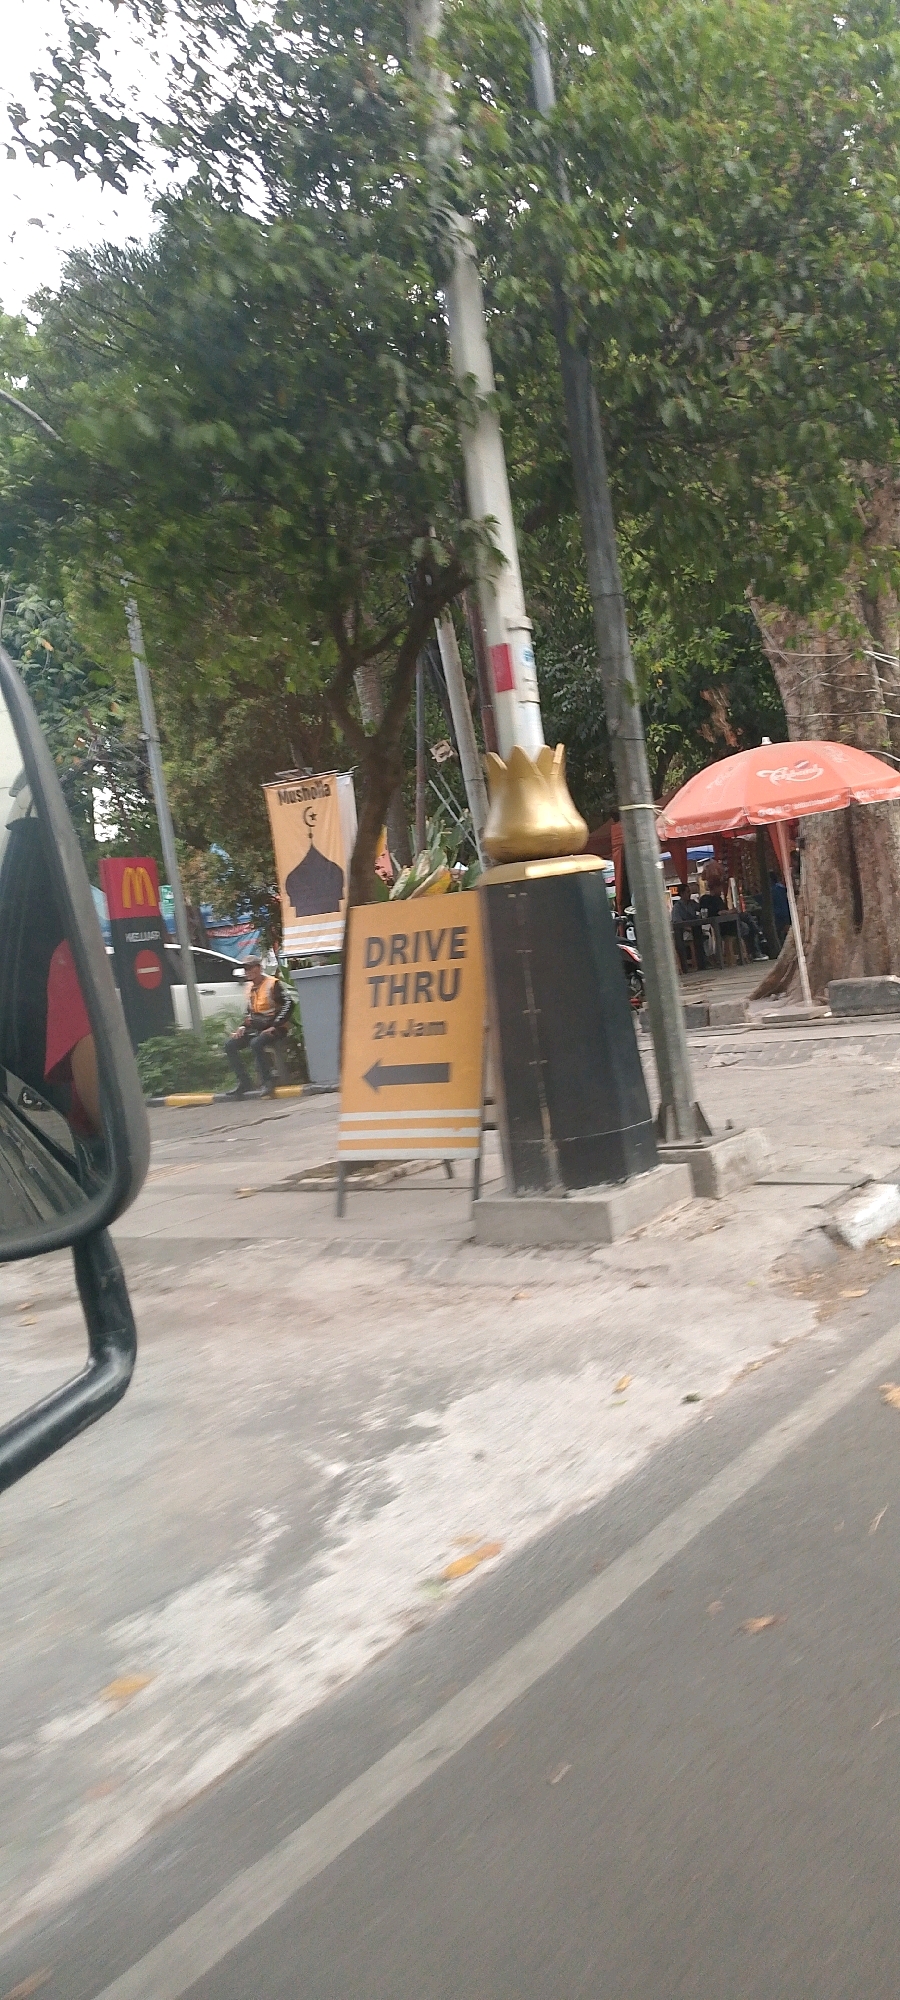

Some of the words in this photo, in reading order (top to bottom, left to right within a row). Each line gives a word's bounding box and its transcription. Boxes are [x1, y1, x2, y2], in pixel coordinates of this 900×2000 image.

[277, 780, 331, 806] Musholla
[363, 925, 468, 968] DRIVE
[367, 968, 461, 1008] THRU
[373, 1020, 396, 1040] 24
[401, 1018, 447, 1038] Jam
